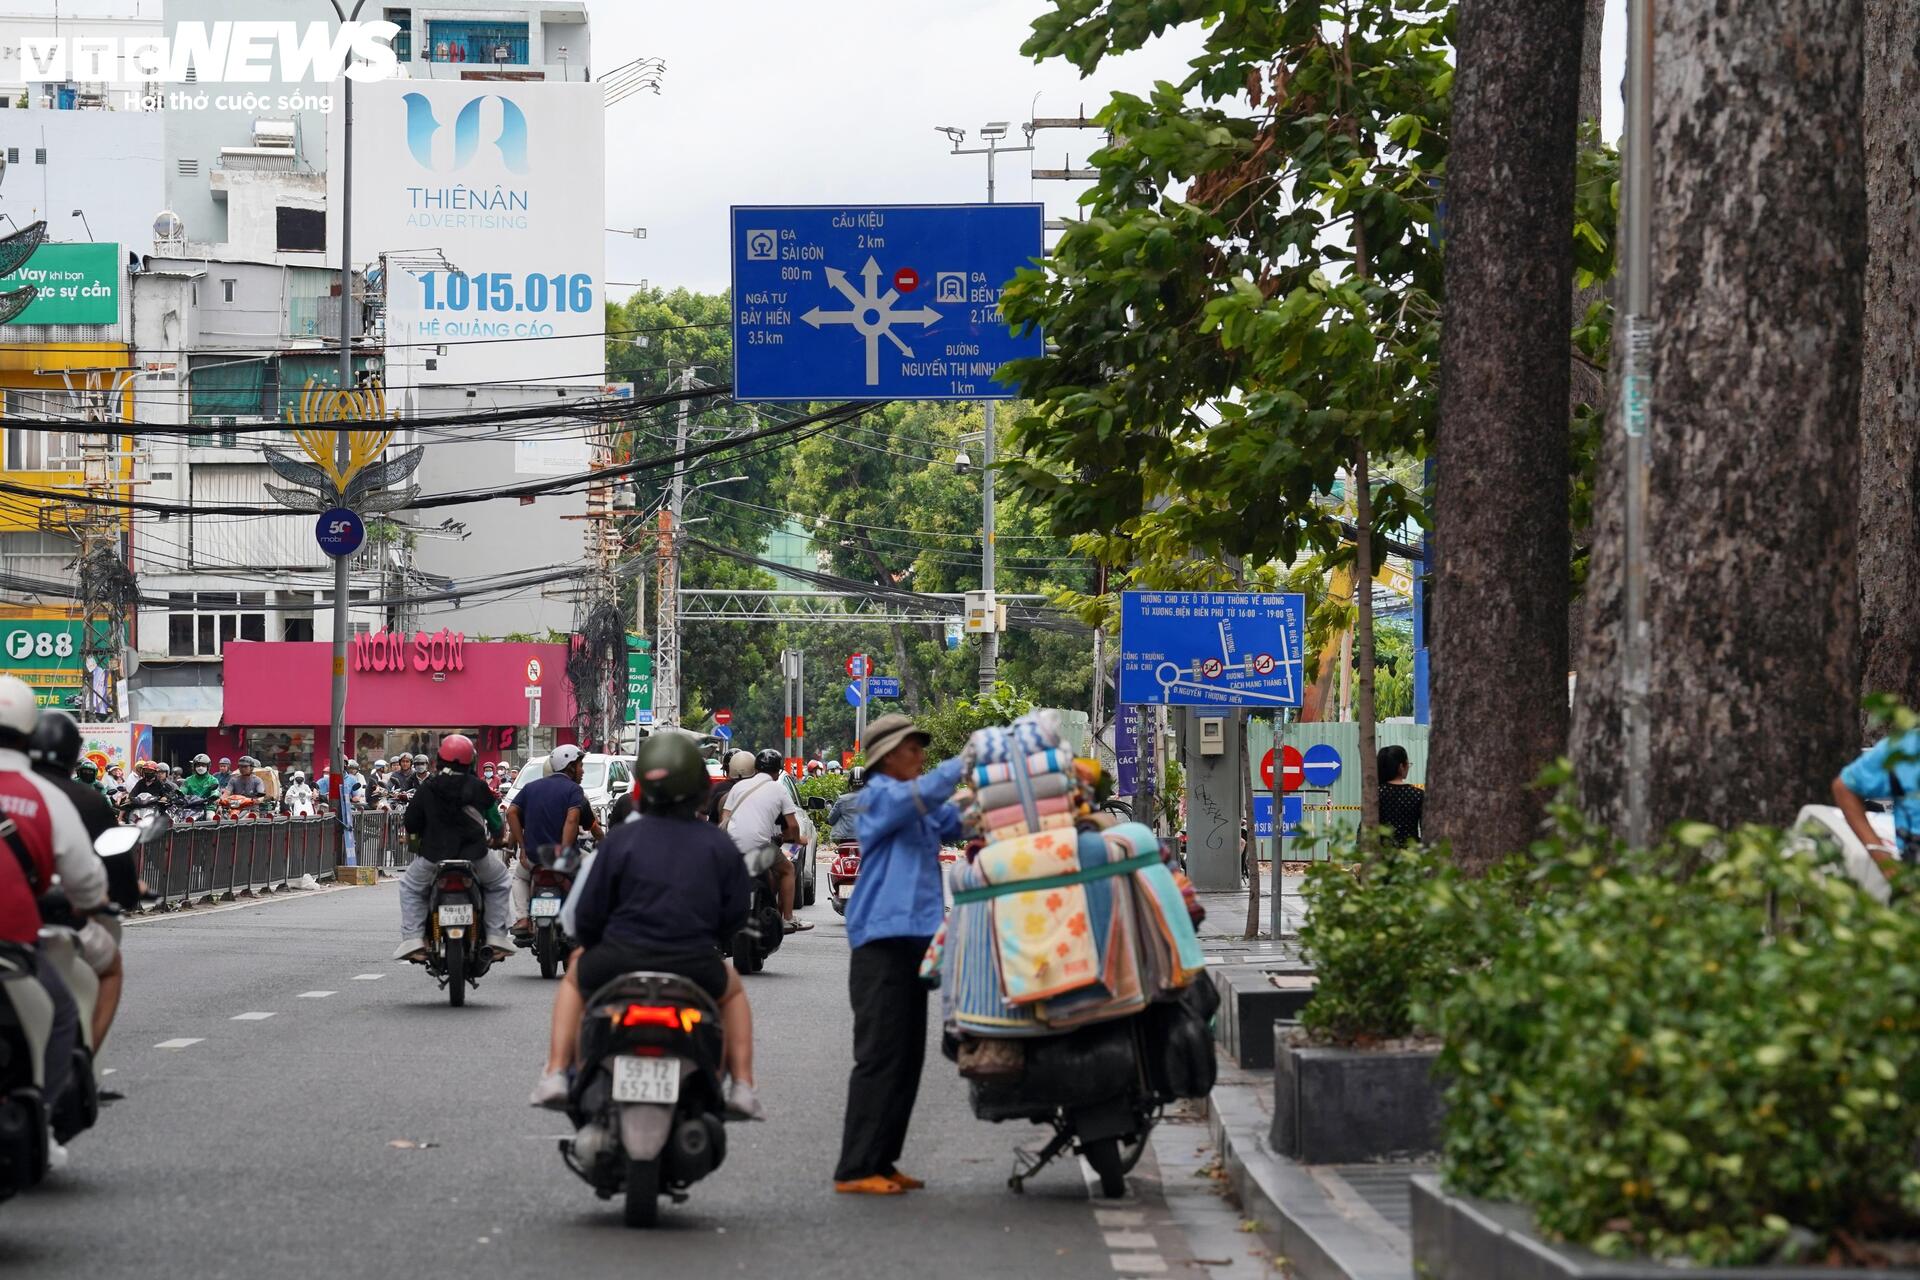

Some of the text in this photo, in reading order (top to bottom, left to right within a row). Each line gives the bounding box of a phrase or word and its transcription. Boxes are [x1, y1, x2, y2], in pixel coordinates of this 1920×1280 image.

[406, 212, 528, 230] ADVERTISING
[832, 211, 884, 231] CẦU KIỆU
[781, 229, 797, 240] GA
[858, 235, 885, 248] 2 km
[782, 242, 824, 260] SÀI GÒN
[19, 268, 47, 282] Vay
[49, 271, 63, 280] khi
[65, 271, 84, 281] bạn
[781, 267, 812, 280] 600 m
[971, 272, 987, 283] GA
[60, 285, 78, 301] sự
[82, 279, 111, 297] cần
[971, 284, 994, 303] BẾN
[745, 291, 787, 304] NGÃ TƯ
[741, 306, 791, 325] BẢY HIỀN
[987, 309, 1004, 323] km
[418, 318, 554, 340] HỆ QUẢNG CÁO
[766, 331, 783, 344] km
[946, 343, 979, 356] ĐƯỜNG
[902, 358, 947, 377] NGUYỄN
[950, 362, 968, 379] THỊ
[970, 362, 996, 376] MINH
[951, 381, 975, 394] 1 km
[1165, 595, 1178, 604] CHO
[1181, 595, 1190, 604] XE
[1193, 594, 1198, 604] Ô
[1201, 594, 1209, 604] TÔ
[1228, 595, 1248, 605] THÔNG
[1251, 595, 1260, 605] VỀ
[1263, 595, 1284, 605] ĐƯỜNG
[1194, 607, 1209, 617] BIÊN
[1211, 607, 1224, 617] PHỦ
[6, 630, 73, 659] F88
[354, 625, 464, 672] NÓN SƠN
[1122, 652, 1164, 661] CÔNG TRƯỜNG
[1125, 662, 1139, 670] DÂN
[1226, 672, 1244, 680] ĐƯỜNG
[1230, 681, 1245, 689] CÁCH
[1246, 680, 1262, 689] MẠNG
[1263, 678, 1282, 687] THÁNG
